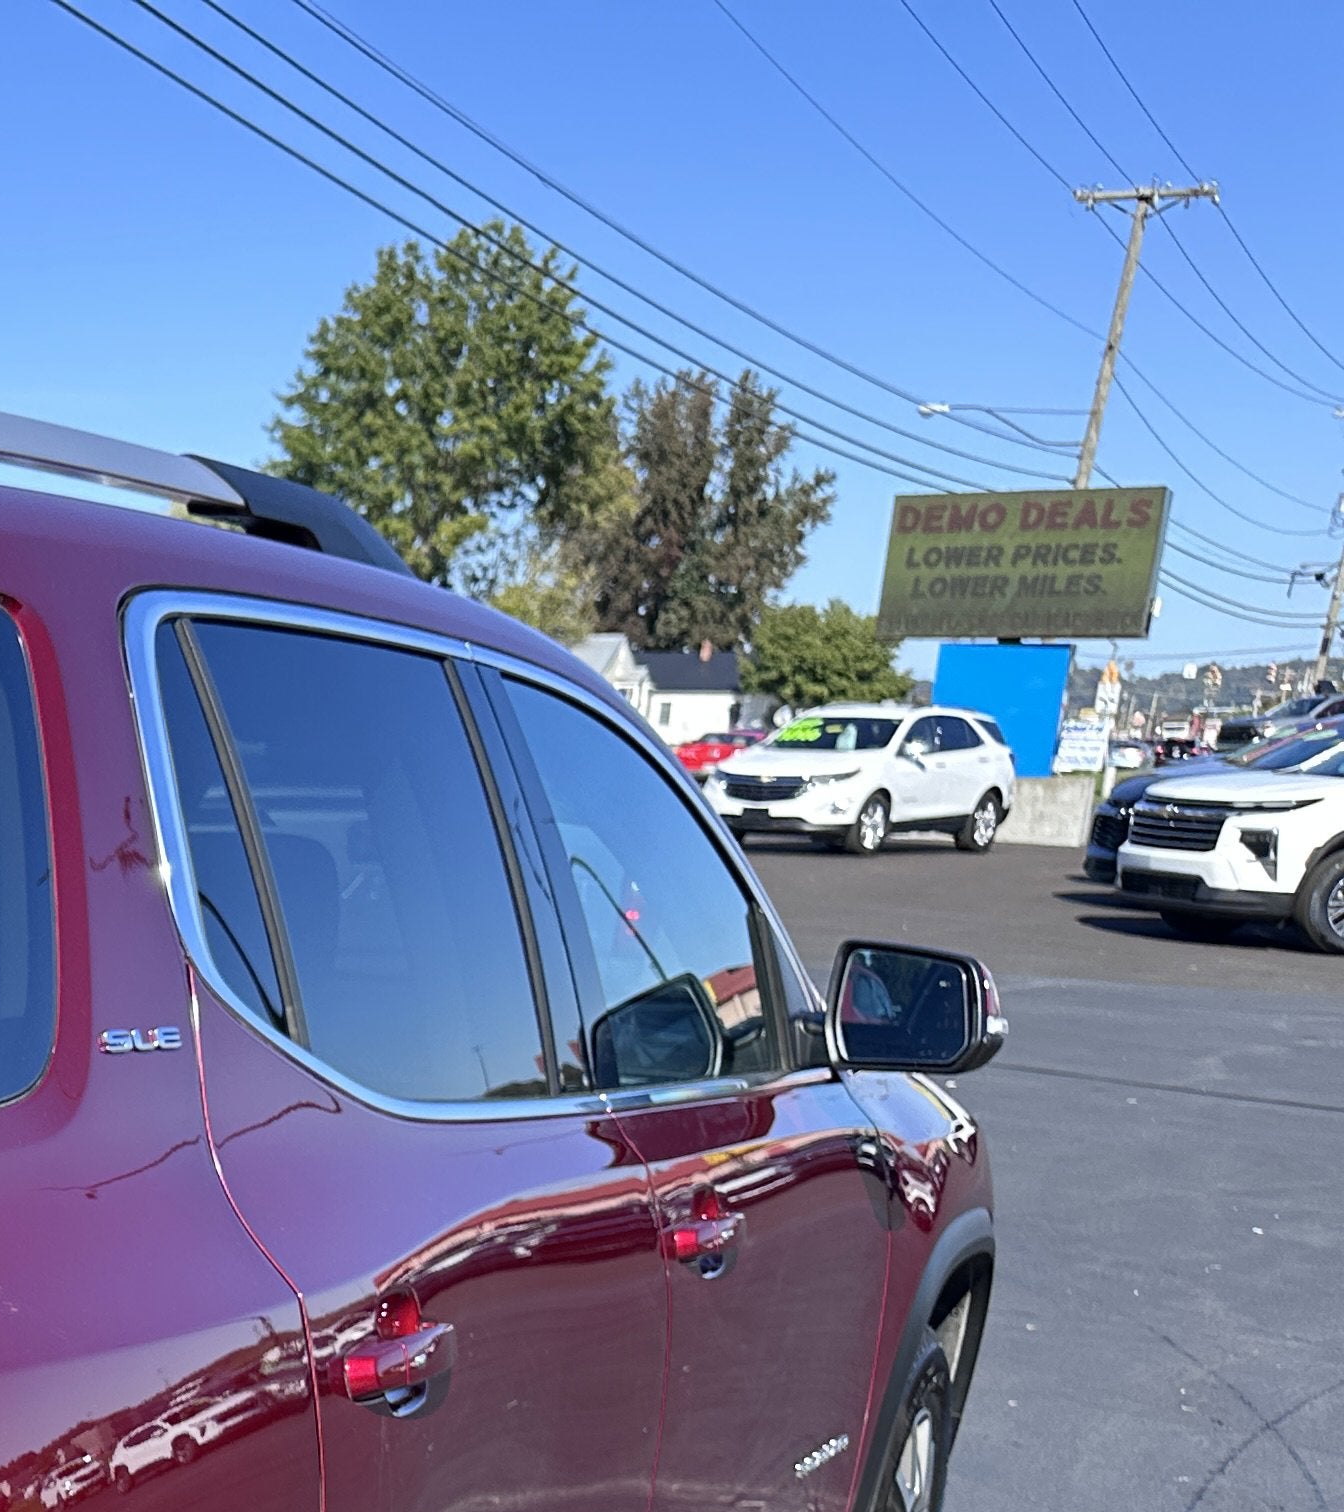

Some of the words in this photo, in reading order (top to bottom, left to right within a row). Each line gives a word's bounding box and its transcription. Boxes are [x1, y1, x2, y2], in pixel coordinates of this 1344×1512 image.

[895, 502, 1007, 534] DEMO
[1019, 498, 1153, 530] DEALS
[905, 545, 1005, 569] LOWER
[1010, 542, 1123, 568] PRICES.
[912, 574, 1010, 599] LOWER
[1014, 572, 1108, 597] MILES.
[97, 1025, 183, 1054] SLE
